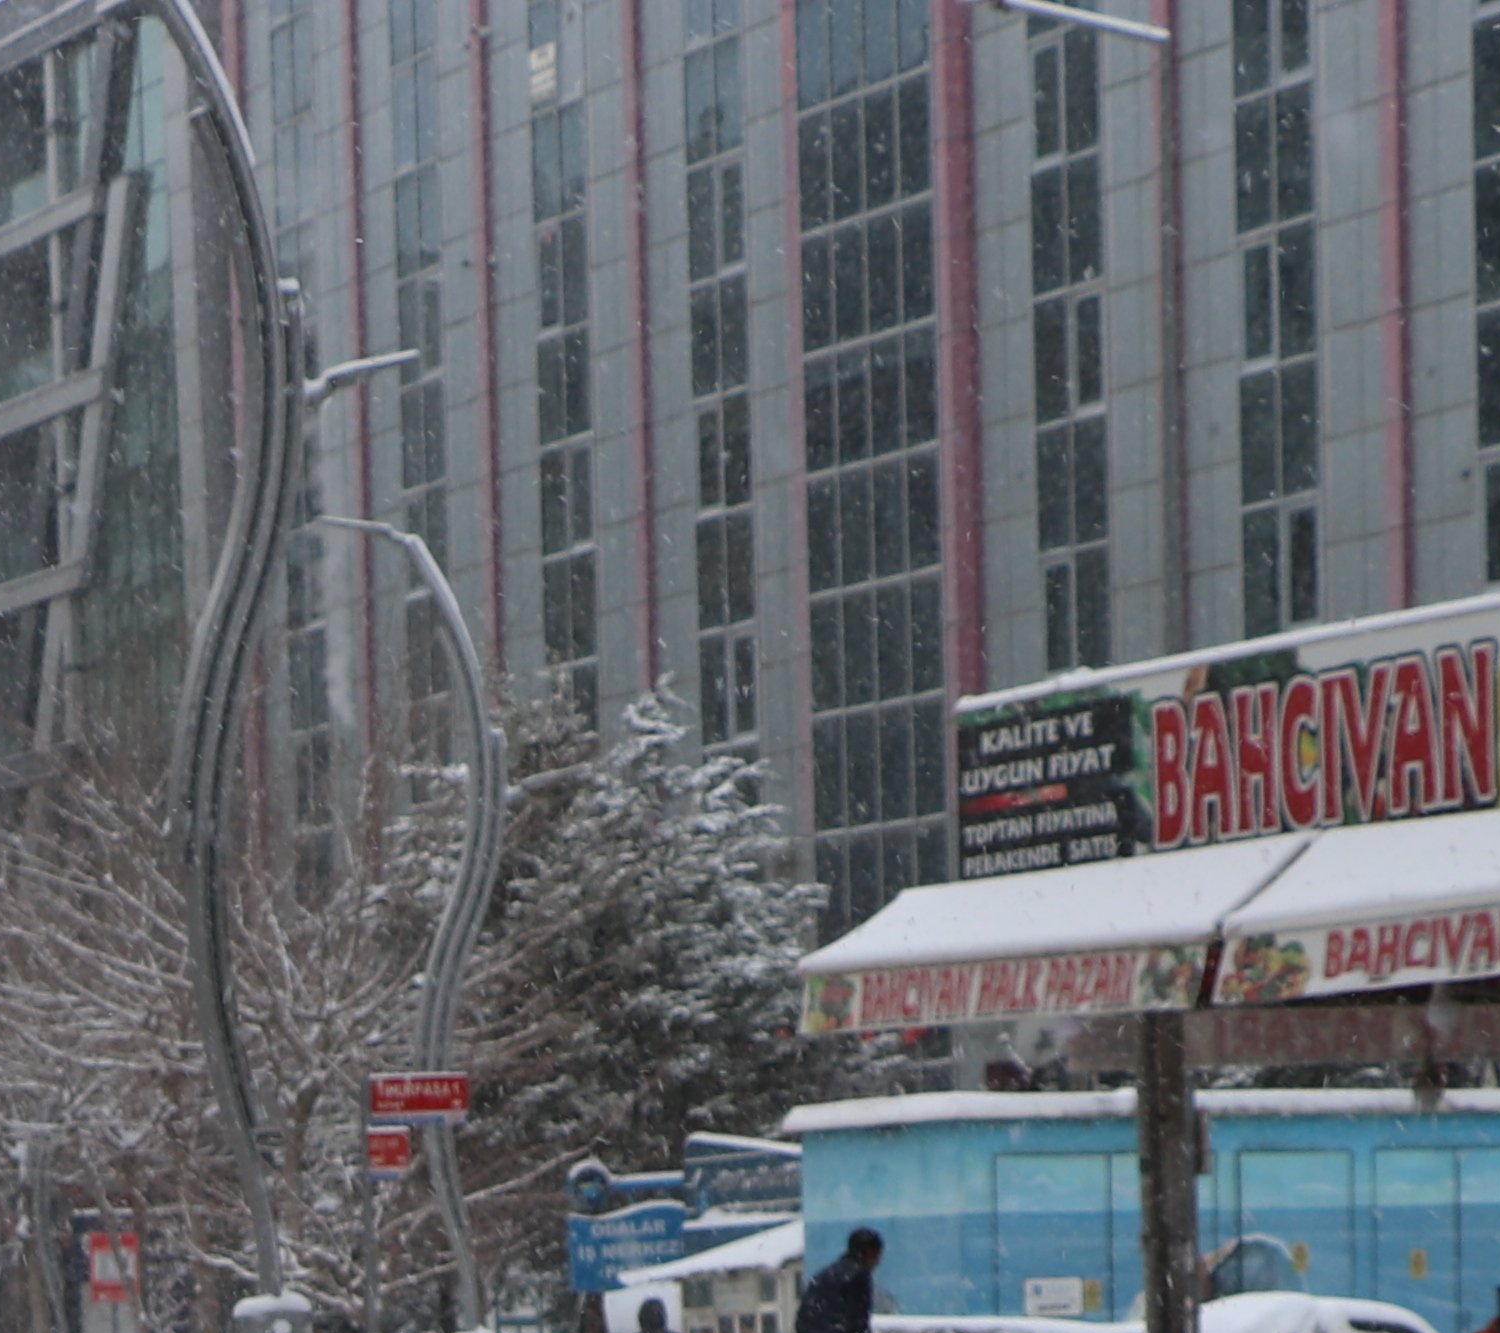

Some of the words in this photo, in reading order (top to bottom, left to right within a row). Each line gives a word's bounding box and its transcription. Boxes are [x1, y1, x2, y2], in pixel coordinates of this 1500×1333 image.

[980, 712, 1060, 756] KALİTE
[1064, 711, 1094, 738] VE
[961, 757, 1044, 796] UYGUN
[1049, 743, 1116, 779] FİYAT
[963, 815, 1033, 847] TOPTAN
[1035, 800, 1119, 834] FİYATINA
[963, 843, 1061, 877] PERAKENDE
[979, 957, 1038, 1014] HALK
[1040, 952, 1139, 1007] PAZARI
